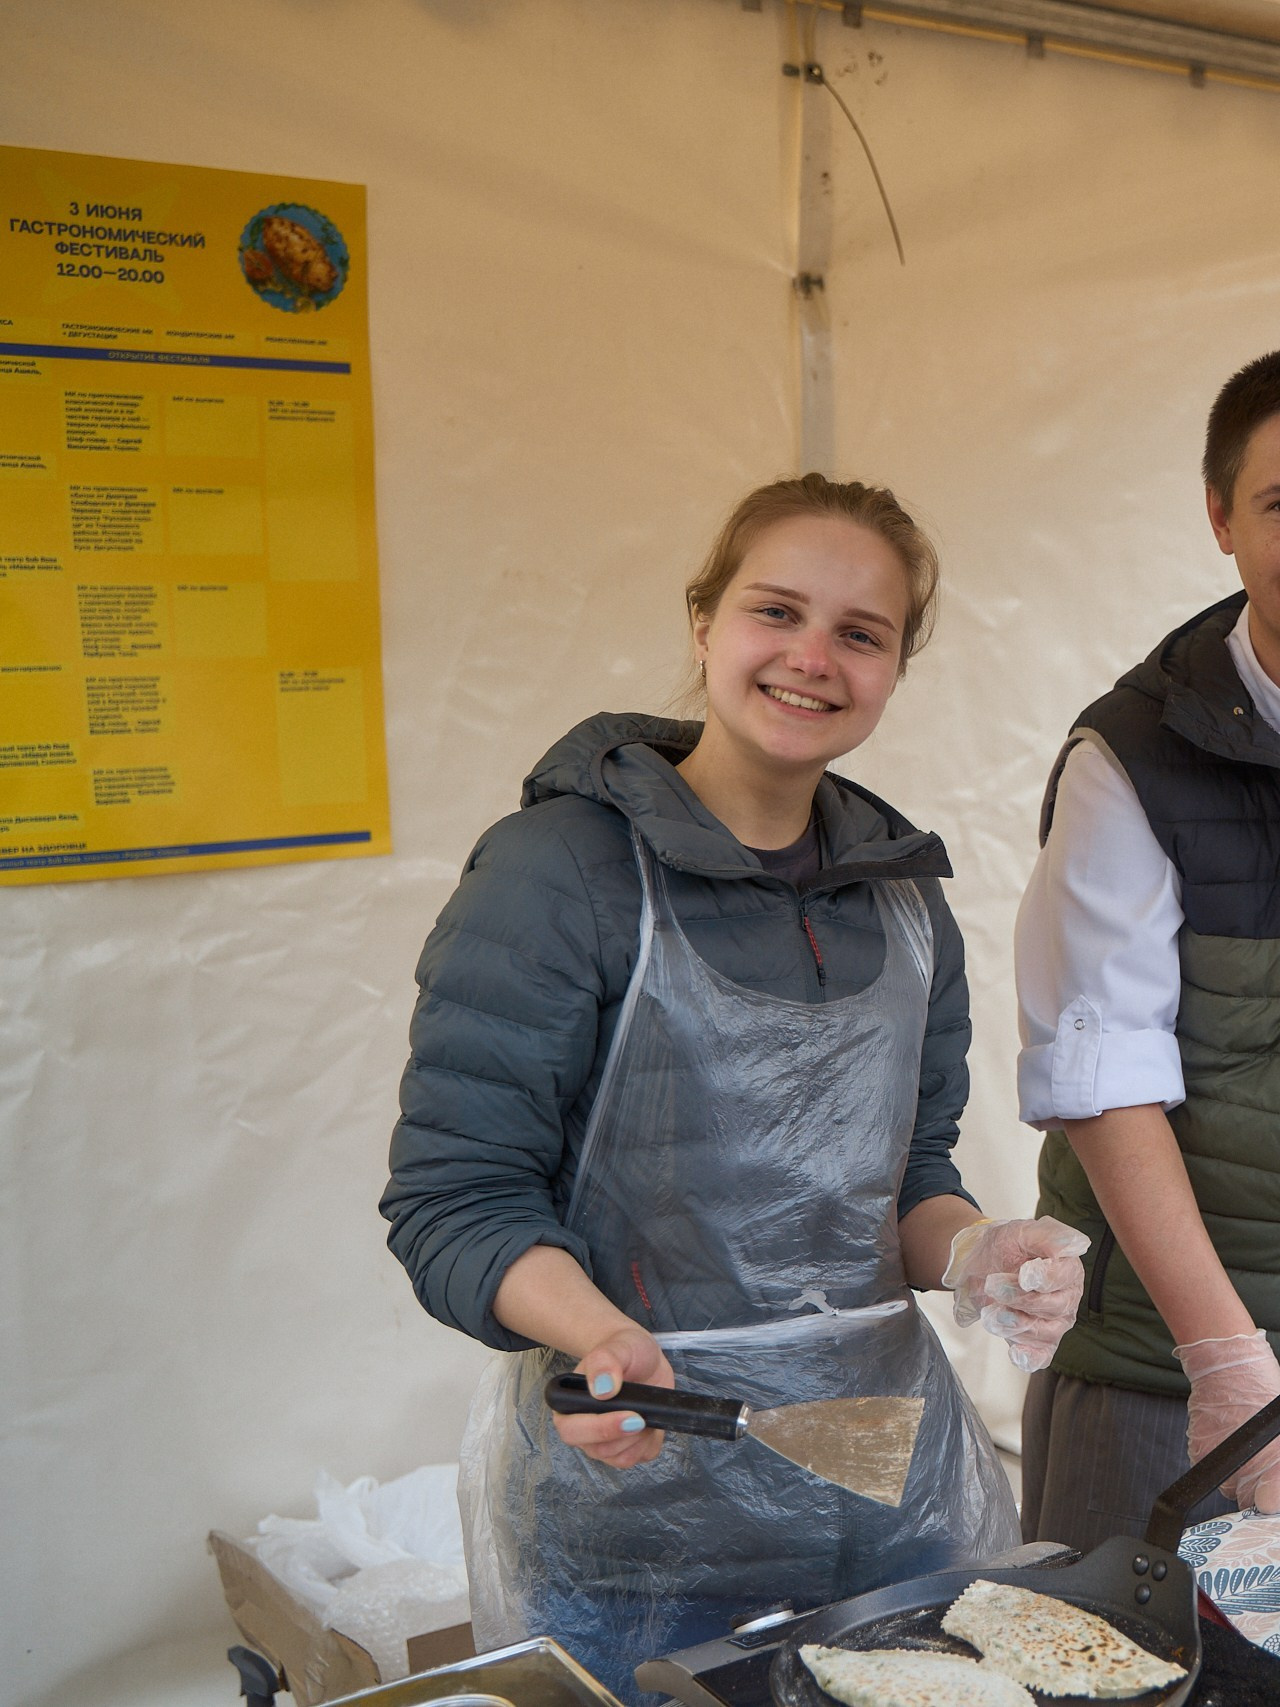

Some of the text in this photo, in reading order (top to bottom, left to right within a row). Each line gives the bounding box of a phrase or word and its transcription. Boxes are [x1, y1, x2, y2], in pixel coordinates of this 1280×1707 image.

[69, 201, 142, 222] 3 ИЮНЯ
[9, 218, 206, 249] ГАСТРОНОМИЧЕСКИЙ
[55, 242, 164, 263] ФЕСТИВАЛЬ
[108, 351, 155, 361] ОТКРЫТИЕ
